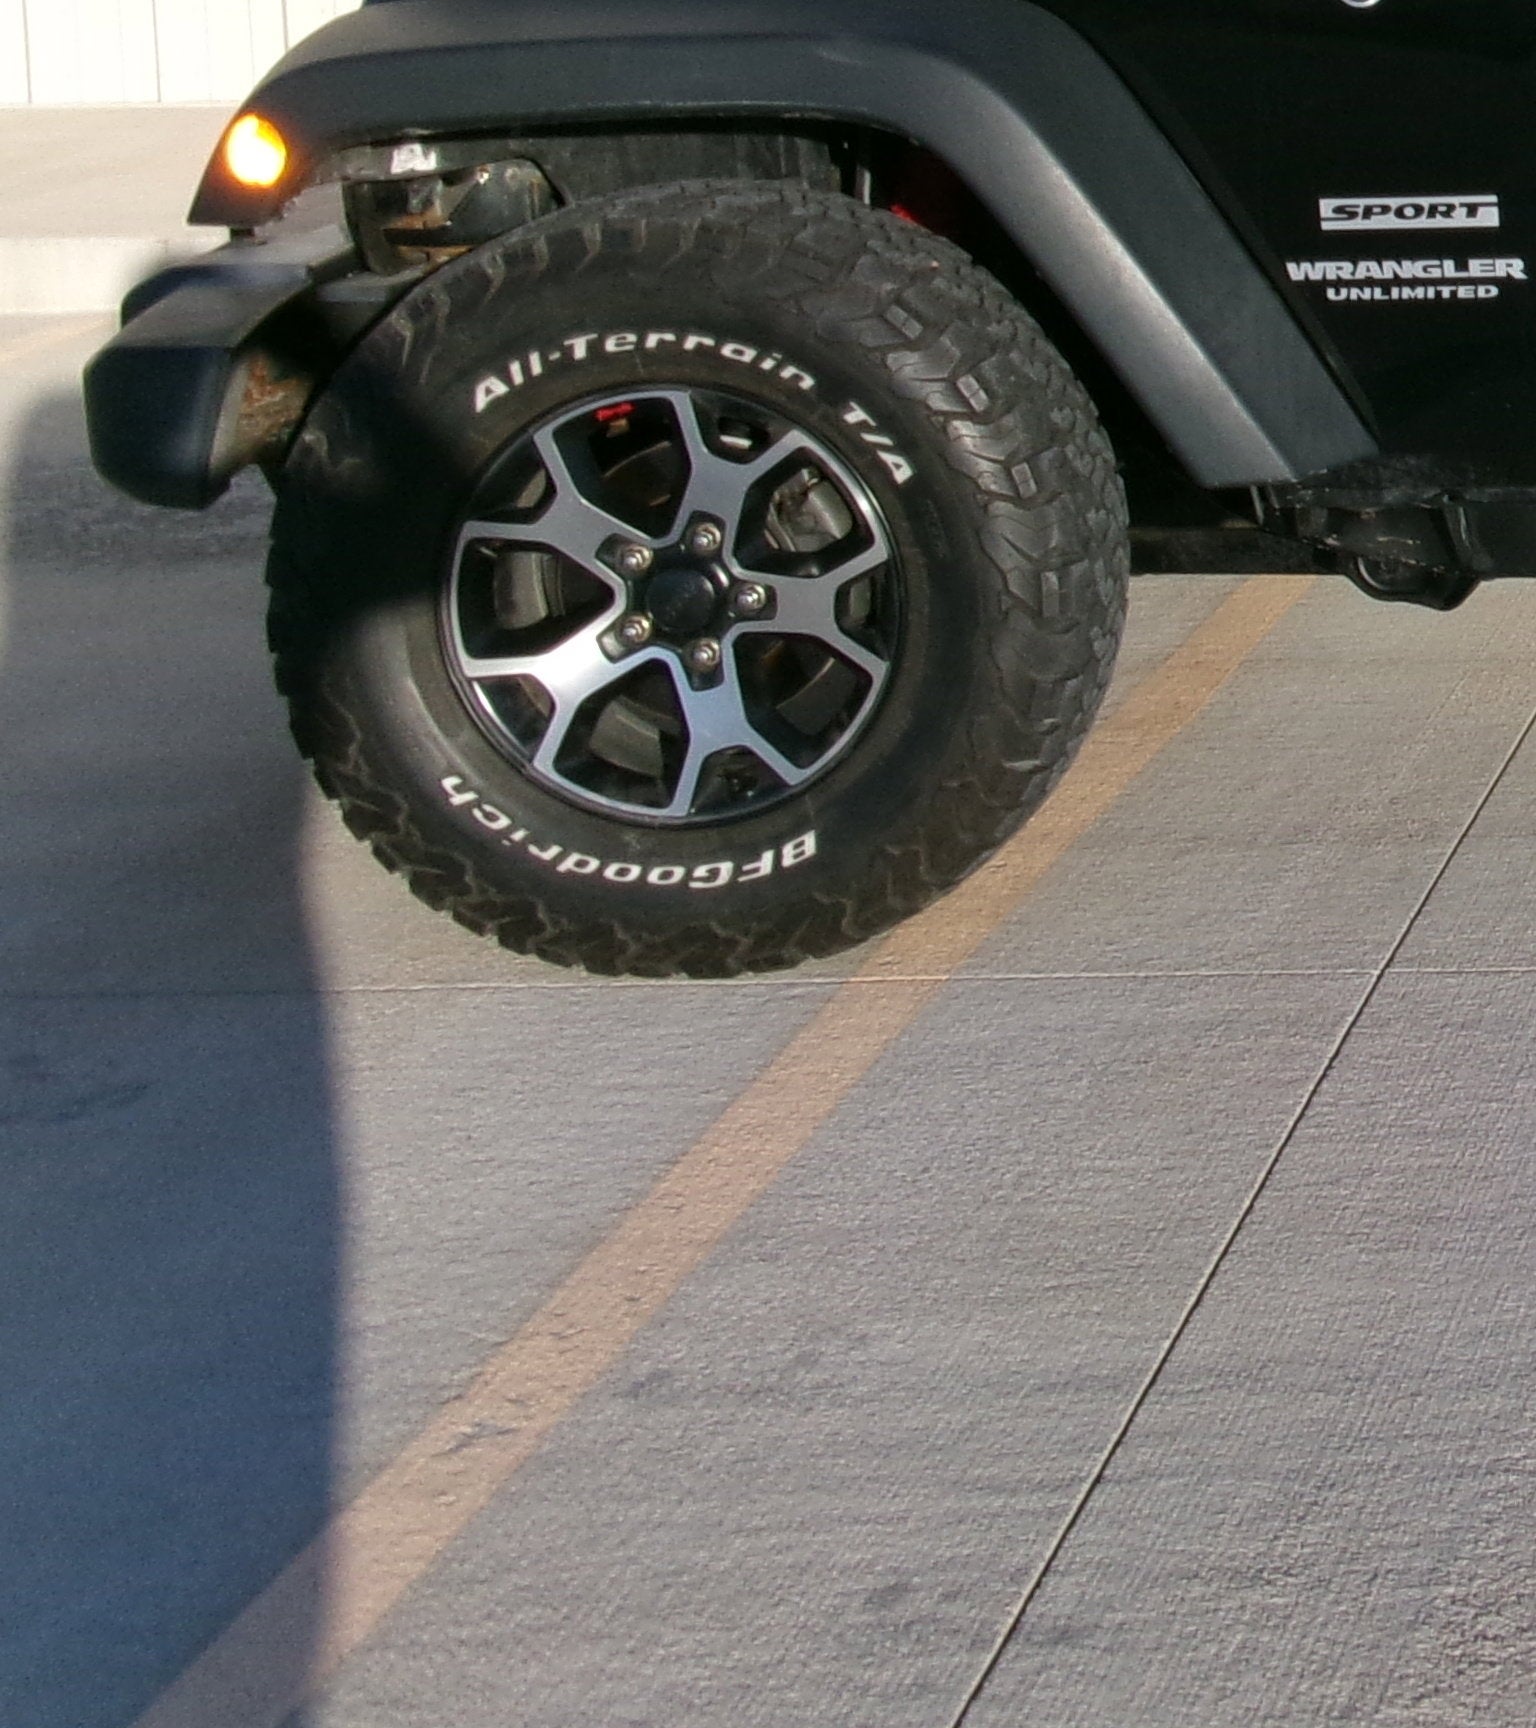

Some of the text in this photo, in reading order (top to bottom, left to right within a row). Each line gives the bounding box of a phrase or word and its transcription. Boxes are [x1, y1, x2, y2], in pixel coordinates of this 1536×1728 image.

[1330, 202, 1488, 221] SPORT
[1285, 258, 1529, 281] WRANGLER
[1326, 285, 1500, 301] UNLIMITED
[471, 330, 916, 487] All-Terrain T/A
[437, 773, 819, 890] BFGoodrich
